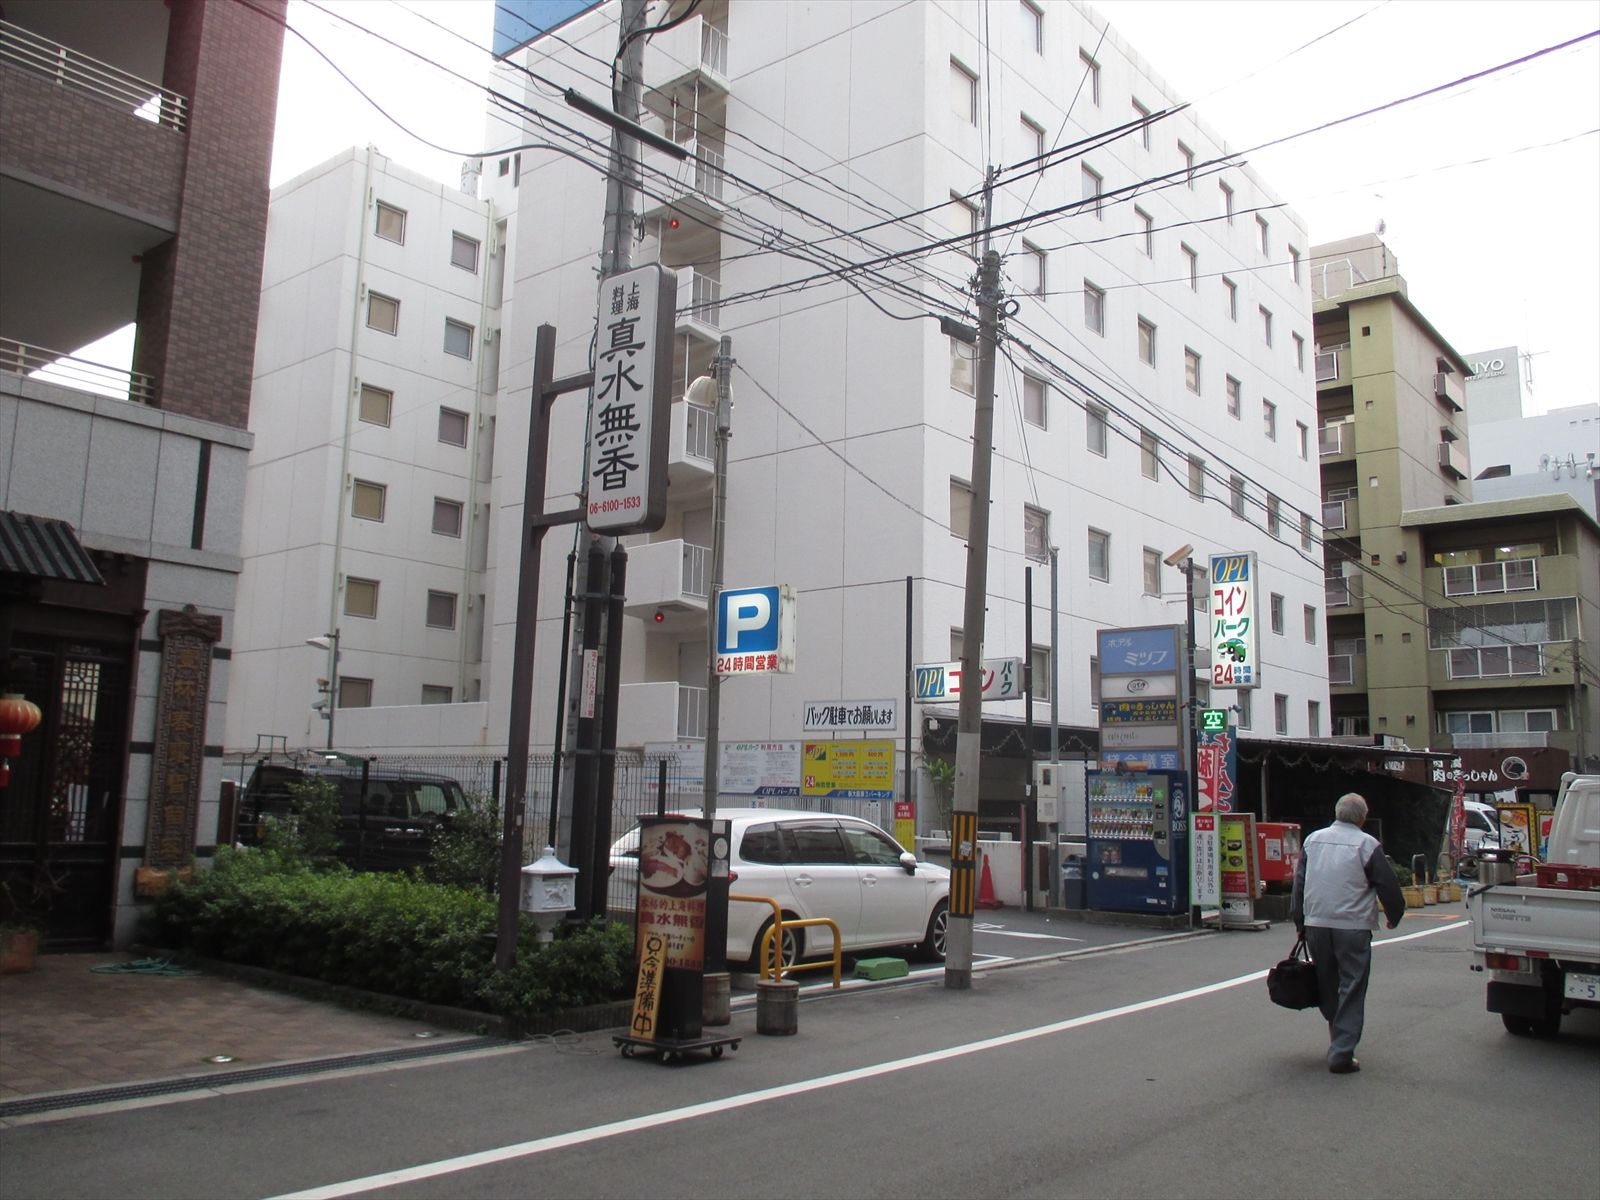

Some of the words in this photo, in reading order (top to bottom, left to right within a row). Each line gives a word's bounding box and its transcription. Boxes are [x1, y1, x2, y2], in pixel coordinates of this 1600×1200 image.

[611, 284, 625, 316] 料理
[626, 281, 640, 312] 上海
[592, 316, 646, 492] 真水無香
[589, 496, 642, 515] 06-6100-1533
[1213, 556, 1248, 583] OPL
[1214, 586, 1248, 617] コイン
[725, 593, 771, 649] P
[1214, 617, 1250, 638] パーク
[1107, 638, 1133, 648] ホテル
[717, 654, 778, 673] 24時間営業
[917, 669, 945, 697] OPL
[1001, 661, 1013, 695] パーク
[1214, 664, 1234, 685] 24
[805, 705, 893, 726] バック駐車でお願いします
[1203, 710, 1224, 730] 空
[805, 776, 815, 787] 24
[1171, 820, 1187, 833] BOSS
